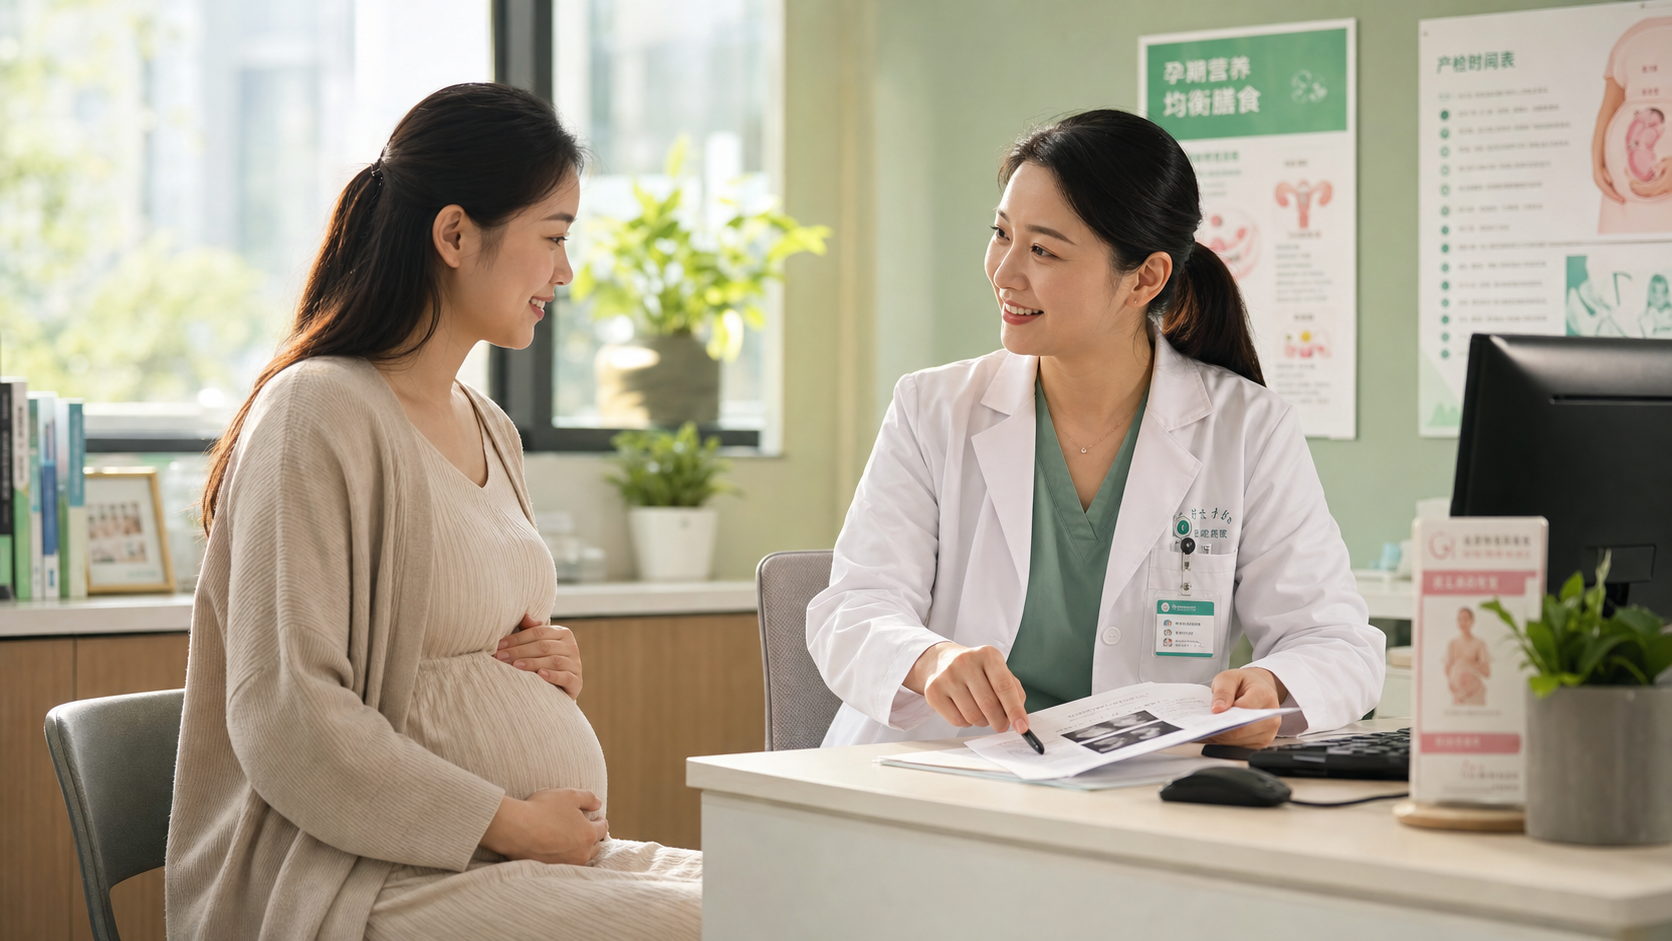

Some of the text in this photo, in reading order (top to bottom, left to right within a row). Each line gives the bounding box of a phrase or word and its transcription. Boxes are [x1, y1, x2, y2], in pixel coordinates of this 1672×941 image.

[1163, 55, 1251, 85] 孕期营养
[1437, 51, 1516, 73] 产检时间表
[1163, 85, 1261, 118] 均衡膳食
